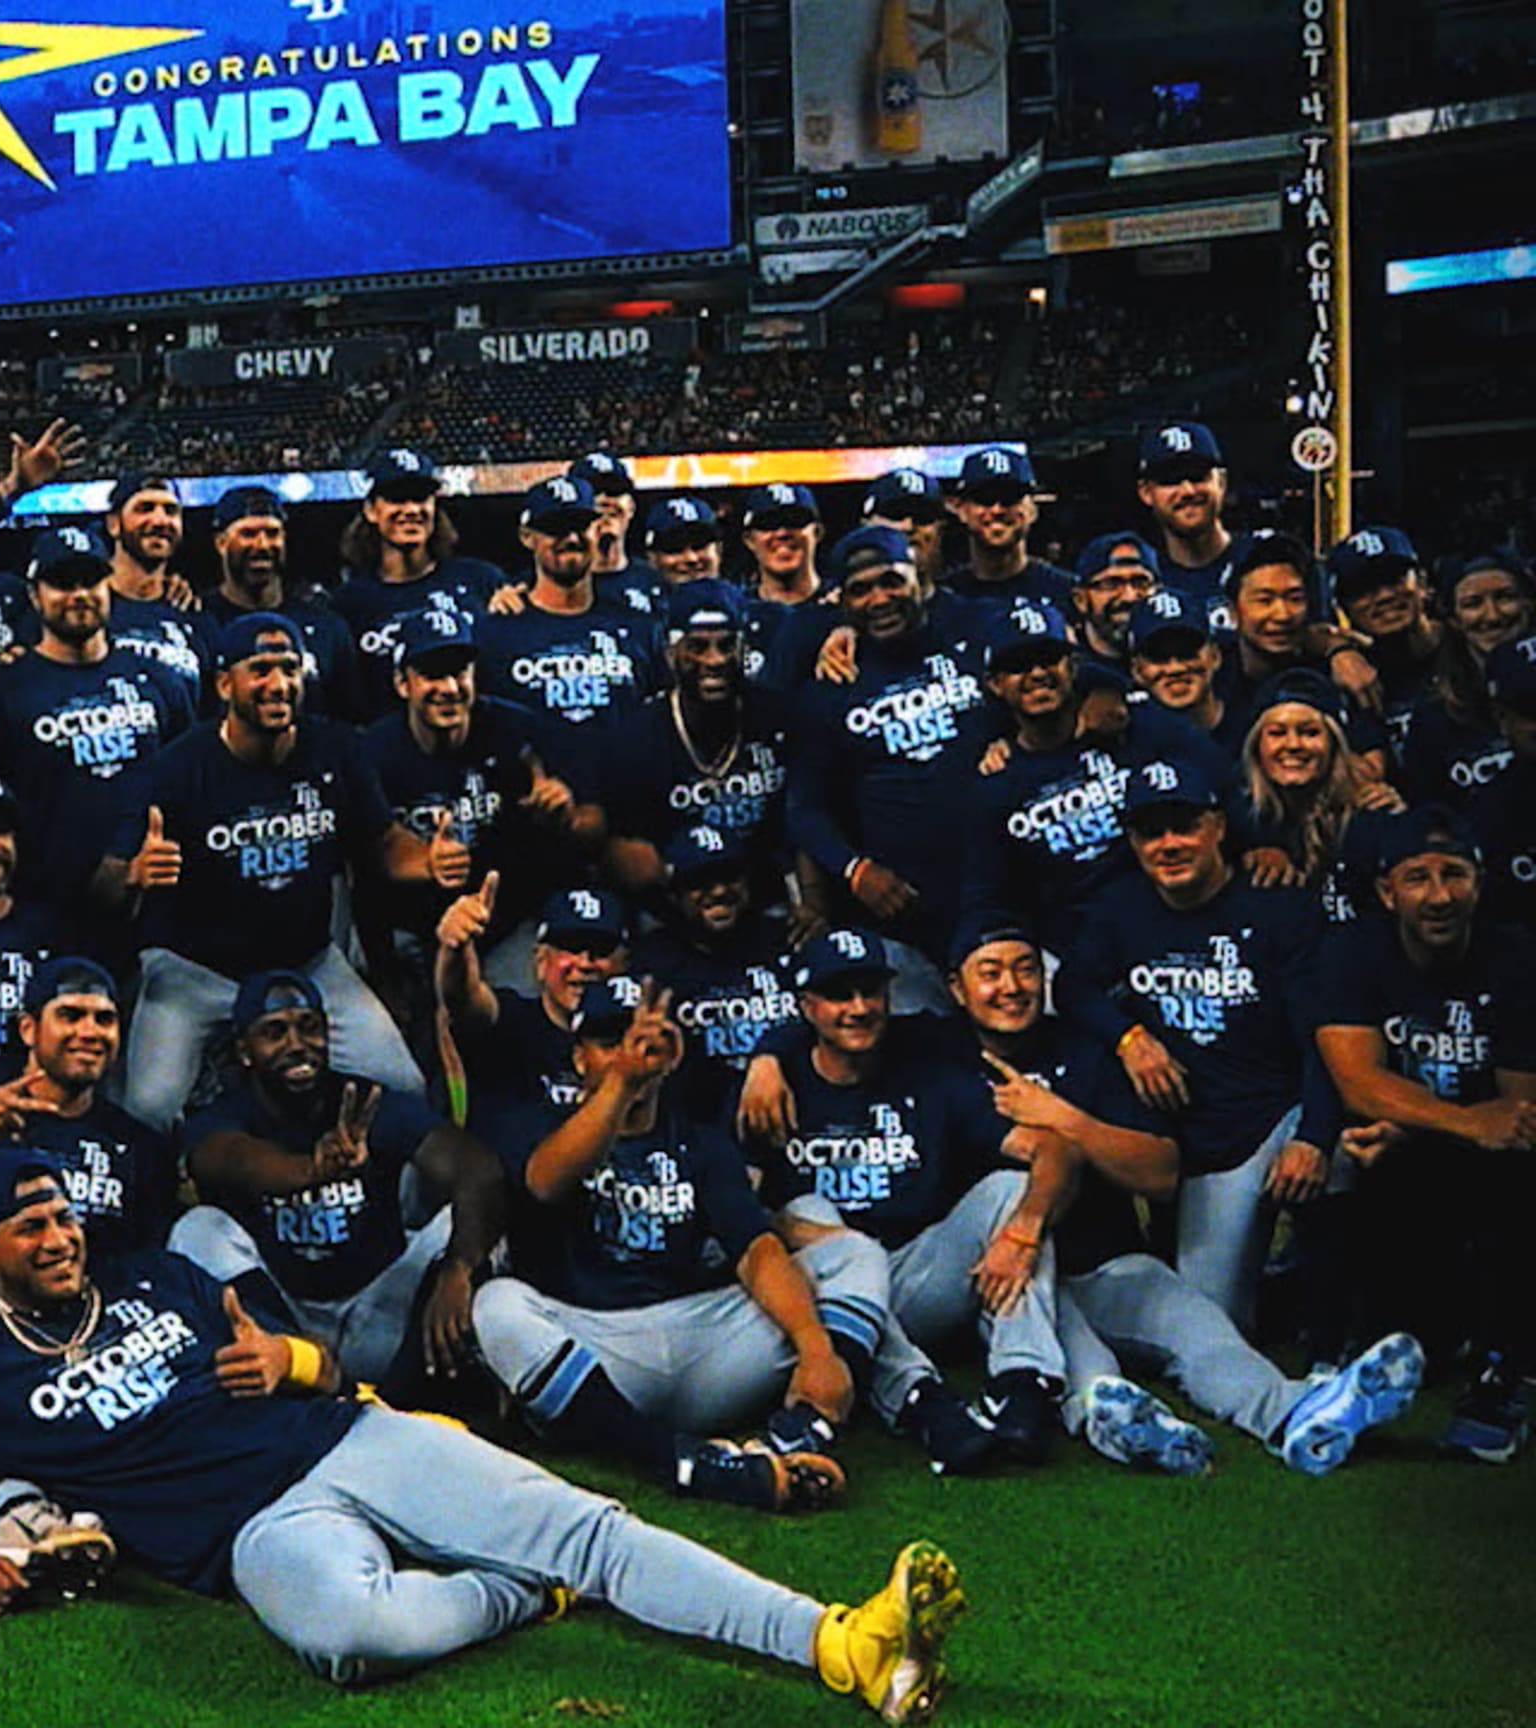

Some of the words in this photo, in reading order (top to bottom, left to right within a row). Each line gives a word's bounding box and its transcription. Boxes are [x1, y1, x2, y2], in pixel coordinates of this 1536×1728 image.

[93, 21, 553, 98] CONGRATULATIONS
[54, 80, 381, 177] TAMPA
[398, 53, 601, 142] BAY
[807, 211, 911, 237] NABORS
[479, 326, 650, 364] SILVERADO
[235, 345, 335, 379] CHEVY
[1161, 427, 1192, 452] TB
[982, 451, 1011, 474] TB
[767, 483, 796, 505] TB
[898, 469, 925, 494] TB
[668, 498, 699, 521] TB
[59, 527, 90, 552] TB
[1349, 530, 1383, 556] TB
[1148, 592, 1182, 618] TB
[423, 611, 458, 637] TB
[1011, 609, 1047, 634] TB
[590, 631, 618, 656] TB
[512, 653, 633, 685] OCTOBER
[925, 653, 958, 681] TB
[108, 678, 139, 703] TB
[544, 678, 611, 710] RISE
[846, 675, 982, 736] OCTOBER
[34, 700, 157, 743] OCTOBER
[883, 708, 959, 756] RISE
[72, 728, 138, 767] RISE
[1080, 749, 1115, 779] TB
[1143, 761, 1179, 791] TB
[291, 780, 321, 809] TB
[207, 809, 336, 851] OCTOBER
[691, 826, 724, 852] TB
[1044, 807, 1125, 856] RISE
[240, 838, 311, 878] RISE
[569, 890, 601, 918] TB
[829, 930, 866, 960] TB
[1209, 934, 1240, 968] TB
[746, 966, 779, 995] TB
[1130, 964, 1258, 999] OCTOBER
[1160, 994, 1227, 1033] RISE
[1446, 1000, 1473, 1036] TB
[869, 1103, 902, 1137] TB
[79, 1139, 110, 1177] TB
[647, 1150, 678, 1184] TB
[786, 1135, 920, 1167] OCTOBER
[814, 1164, 892, 1201] RISE
[275, 1206, 352, 1245] RISE
[106, 1296, 155, 1328] TB
[29, 1309, 195, 1420] OCTOBER
[85, 1356, 178, 1431] RISE
